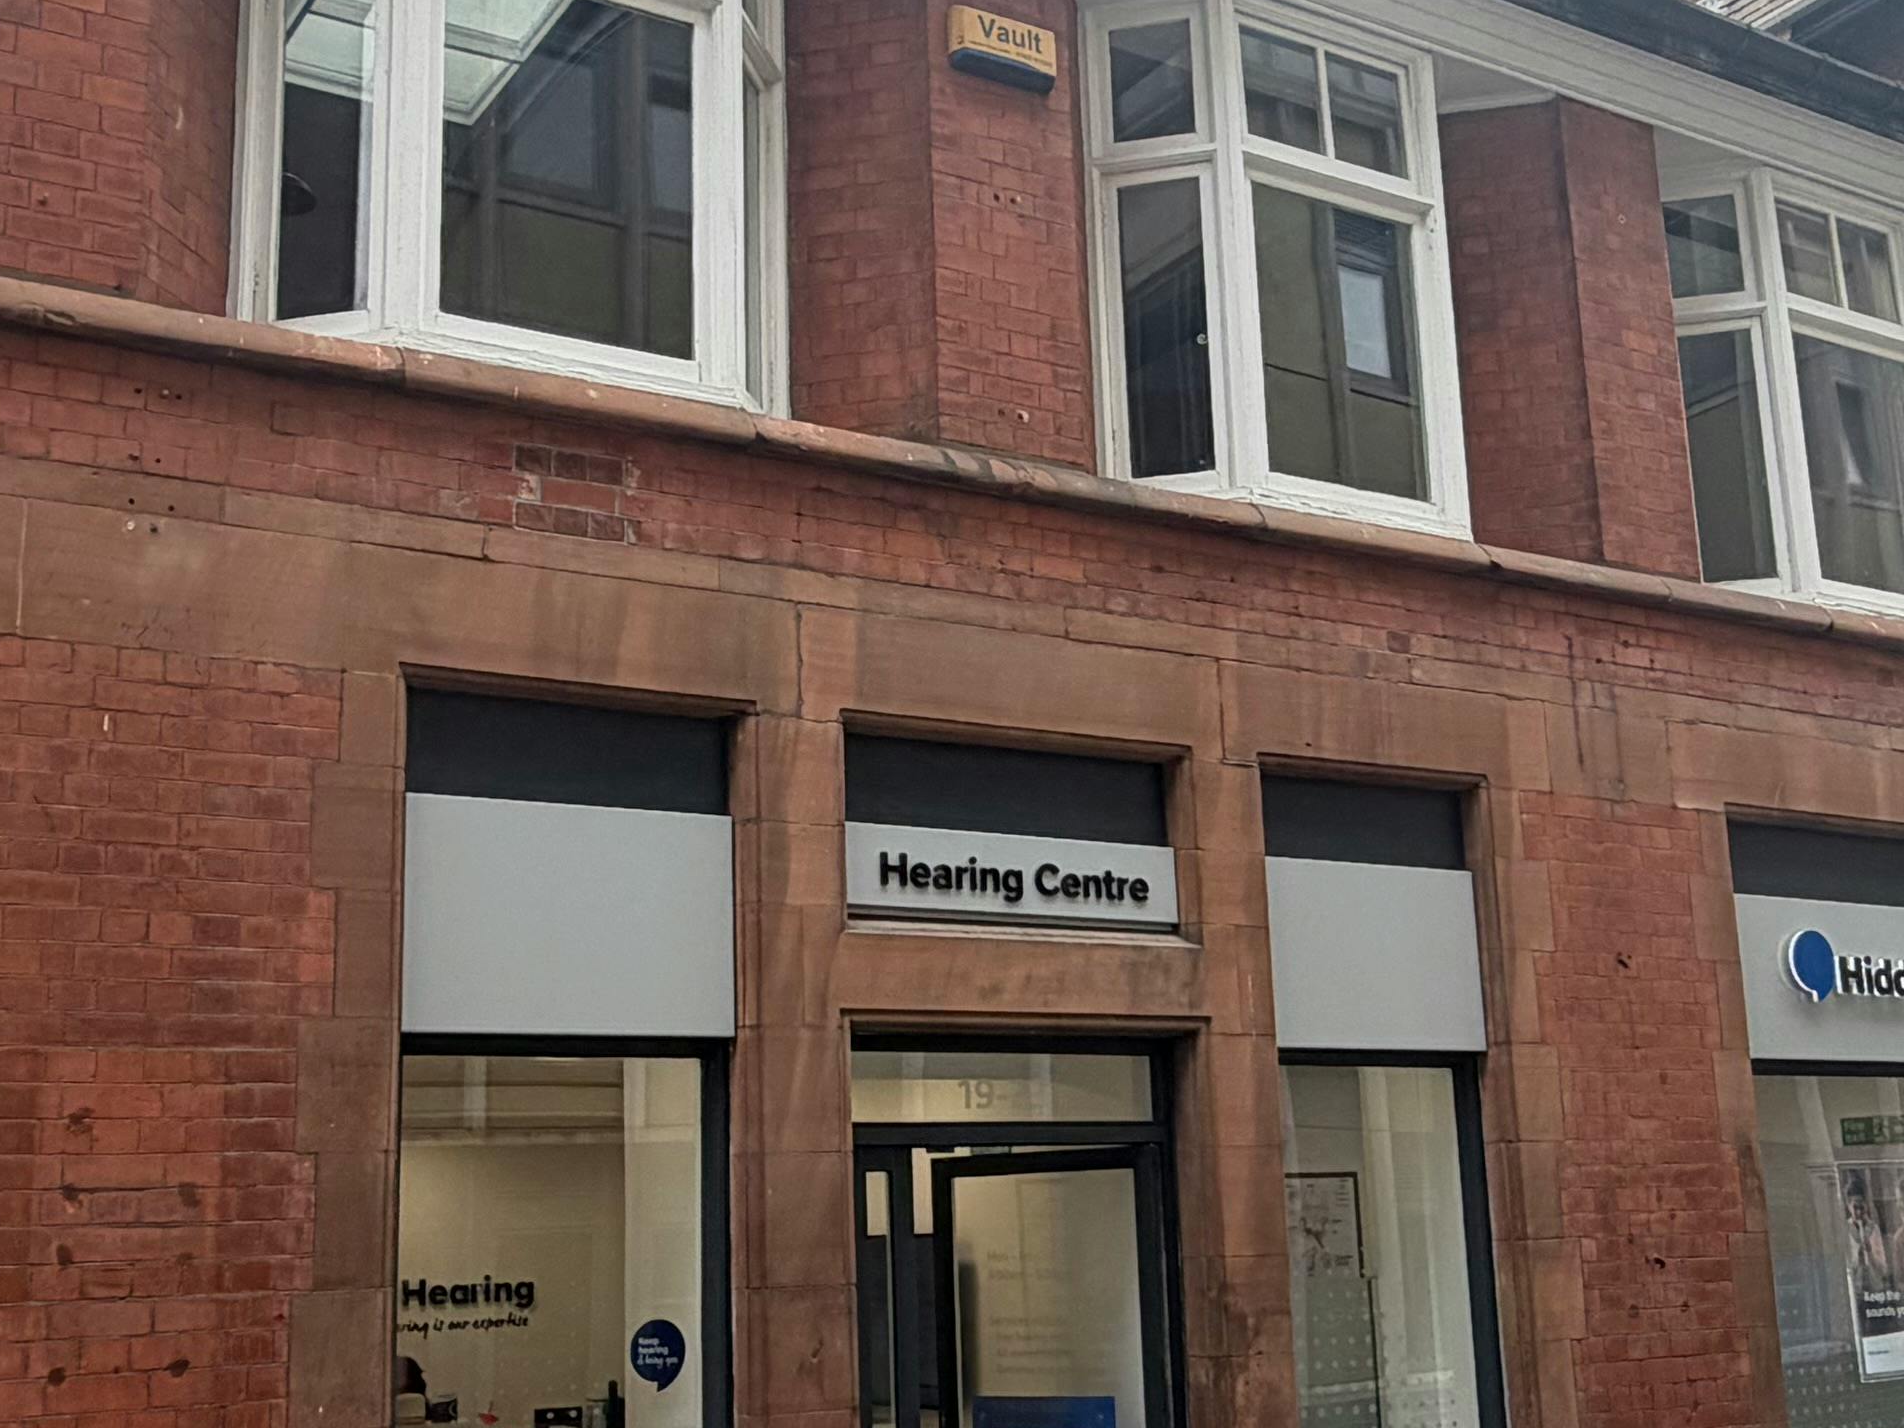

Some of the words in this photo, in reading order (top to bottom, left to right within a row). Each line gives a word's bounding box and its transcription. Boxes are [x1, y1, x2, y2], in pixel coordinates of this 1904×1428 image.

[977, 14, 1043, 54] Vault
[879, 851, 1024, 903] Hearing
[1034, 862, 1150, 902] Centre
[401, 1274, 535, 1309] Hearing
